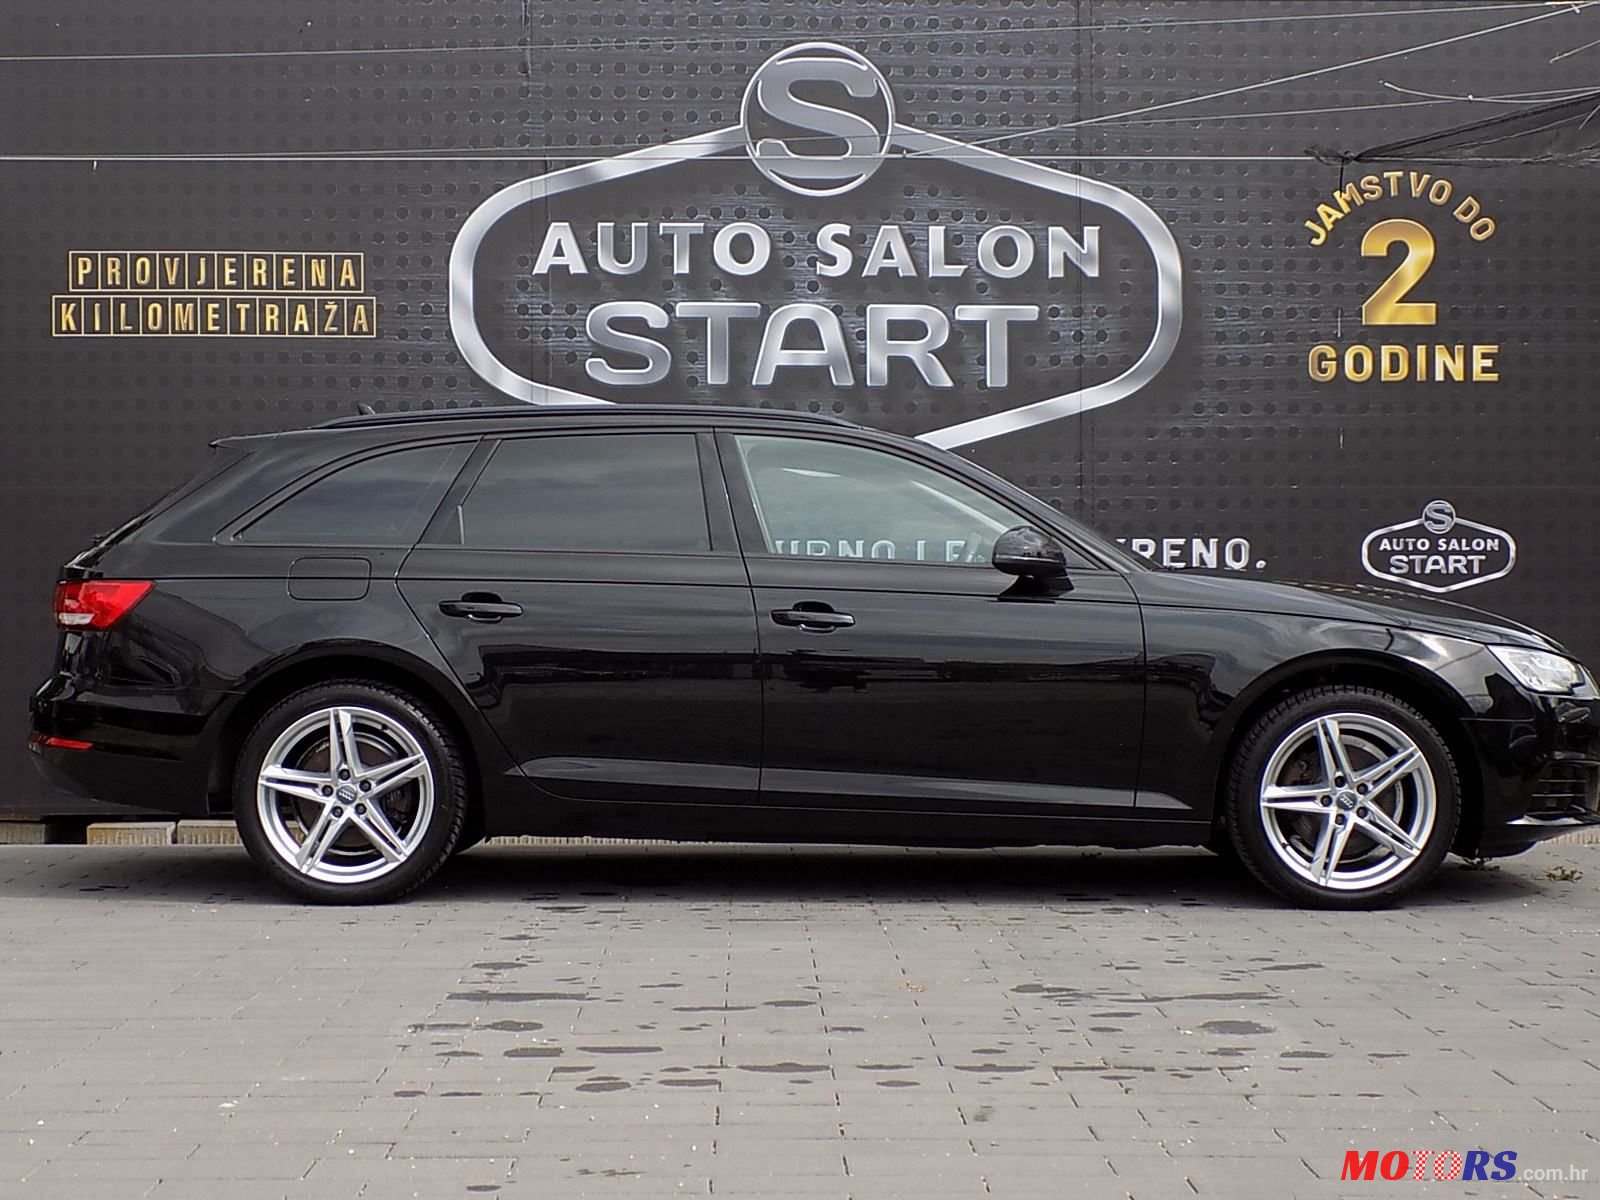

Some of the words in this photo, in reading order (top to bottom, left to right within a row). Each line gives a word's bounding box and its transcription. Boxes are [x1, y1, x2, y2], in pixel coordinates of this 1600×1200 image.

[755, 56, 882, 180] S
[1304, 171, 1453, 246] JAMSTVO
[1453, 196, 1496, 241] DO
[532, 221, 771, 275] AUTO
[815, 224, 1101, 279] SALON
[76, 256, 357, 288] PROVJERENA
[1361, 218, 1437, 326] 2
[60, 301, 368, 333] KILOMETRAŽA
[584, 301, 1040, 388] START
[1308, 344, 1500, 382] GODINE
[1425, 503, 1453, 531] S
[1115, 537, 1268, 570] RENO.
[1378, 538, 1430, 551] AUTO
[1437, 538, 1500, 551] SALON
[1389, 555, 1487, 575] START
